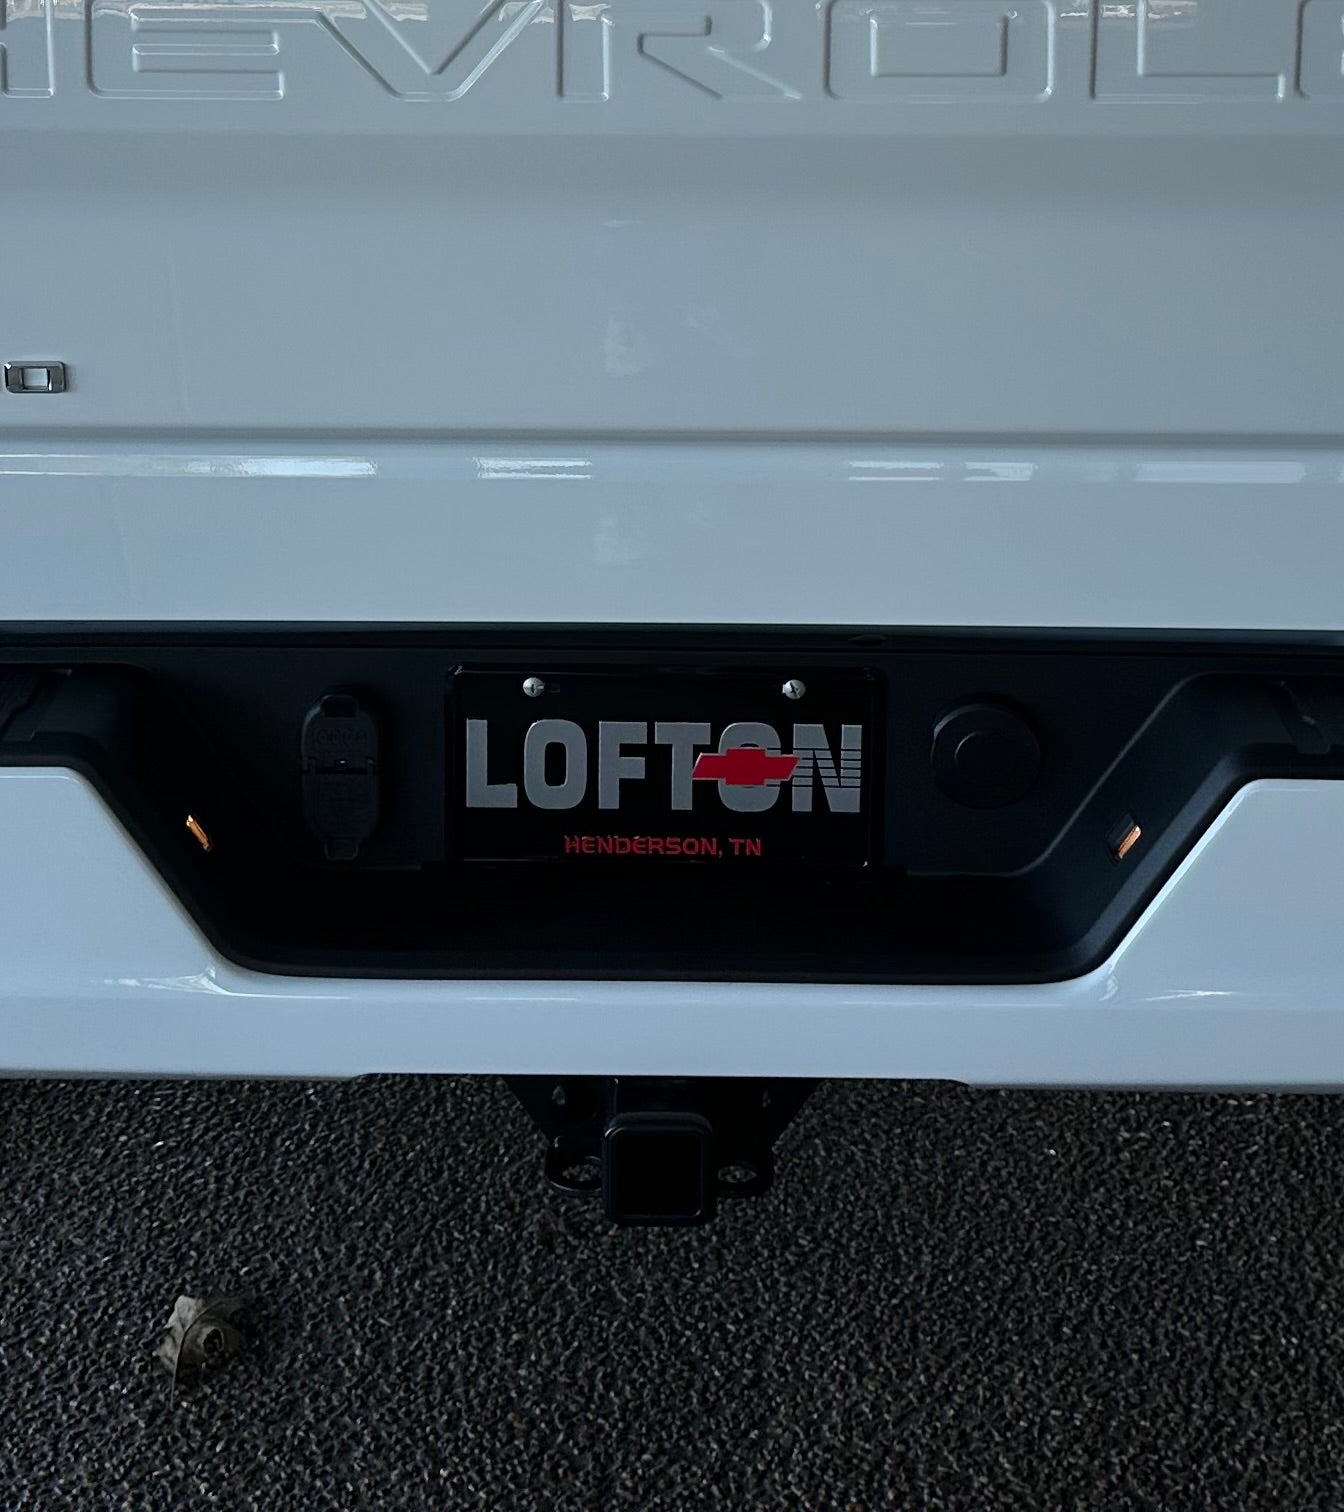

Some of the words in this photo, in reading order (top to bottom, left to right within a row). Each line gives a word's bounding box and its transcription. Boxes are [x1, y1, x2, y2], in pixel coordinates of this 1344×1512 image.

[465, 717, 863, 813] LOFTON
[564, 834, 724, 859] HENDERSON,
[731, 837, 763, 857] TN
